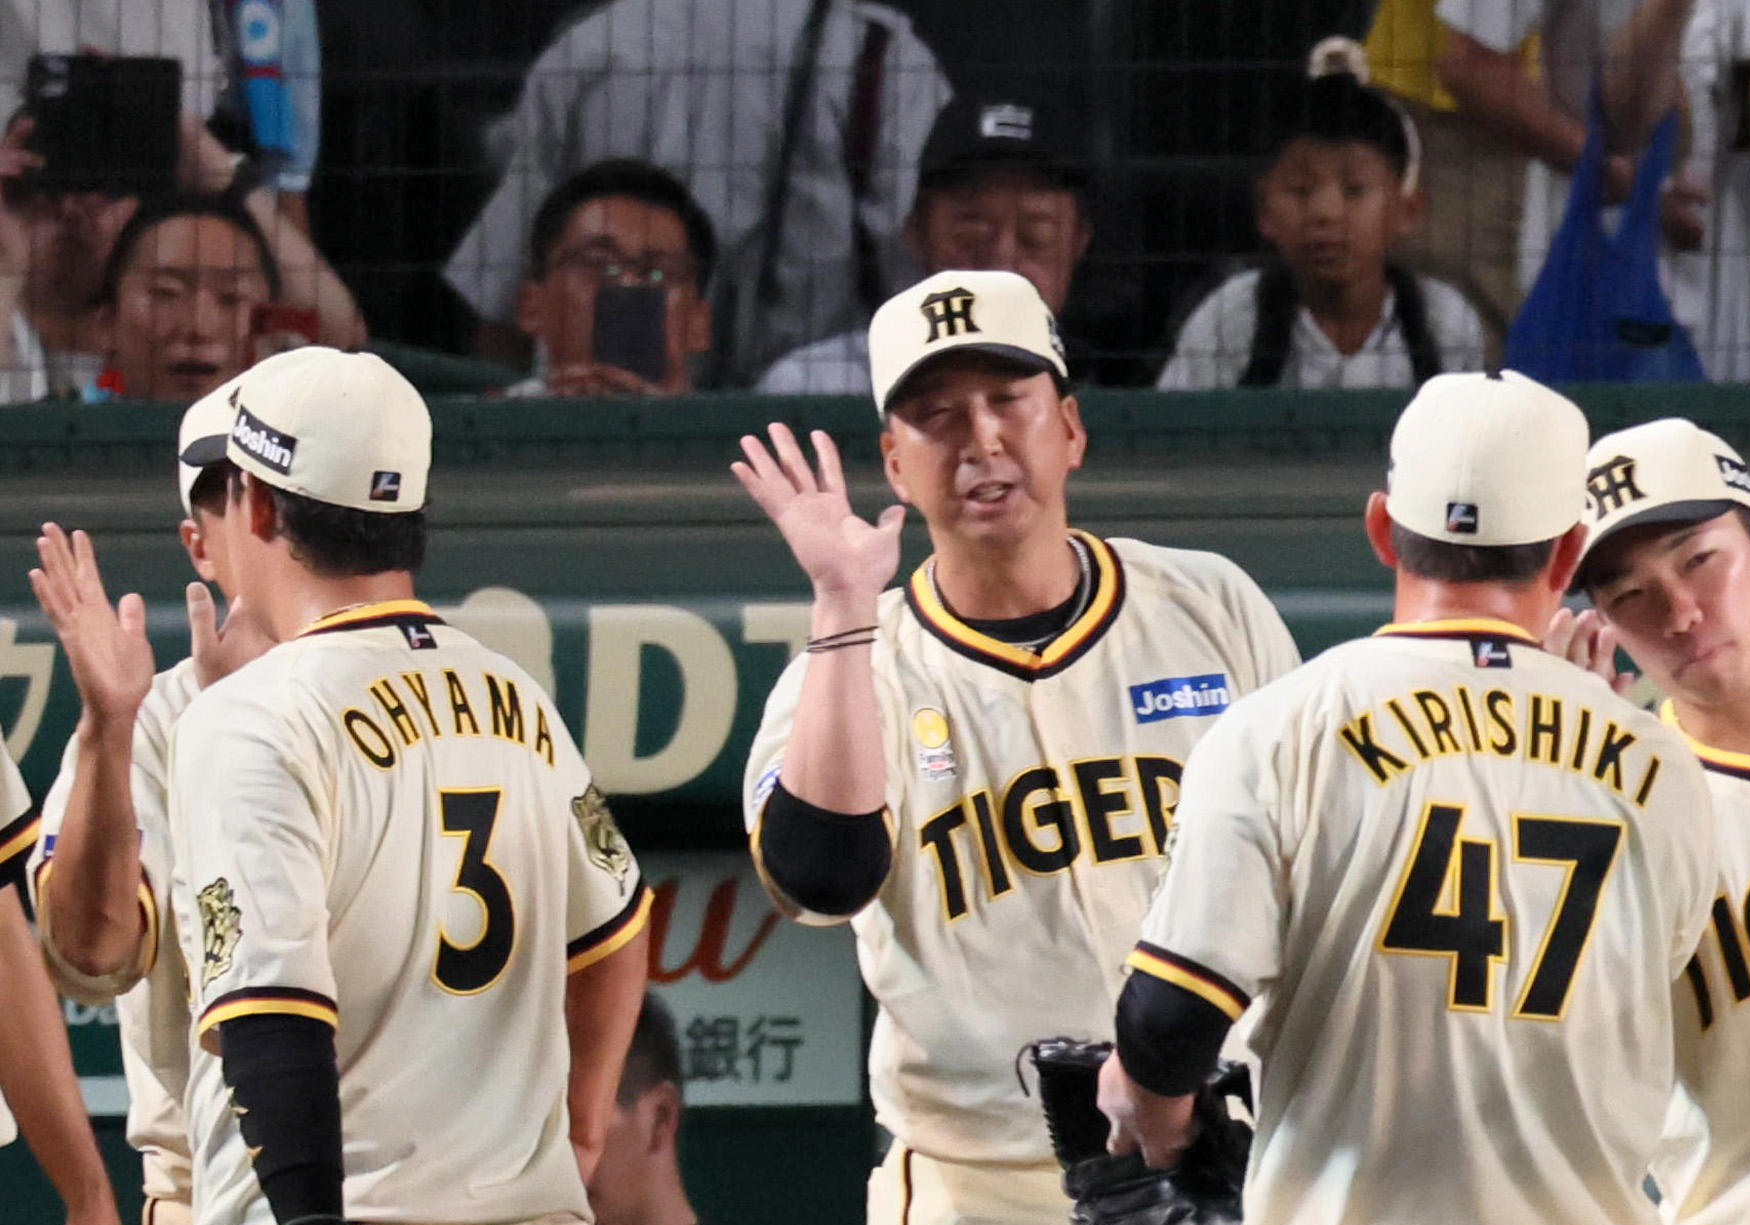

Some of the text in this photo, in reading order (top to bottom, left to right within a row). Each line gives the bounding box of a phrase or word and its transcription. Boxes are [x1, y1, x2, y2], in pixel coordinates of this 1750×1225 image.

[236, 414, 293, 468] Joshin
[341, 668, 556, 773] OHYAMA
[1136, 682, 1230, 715] Joshin
[1337, 684, 1664, 808] KIRISHIKI
[430, 786, 516, 996] 3
[1378, 800, 1622, 1021] 47
